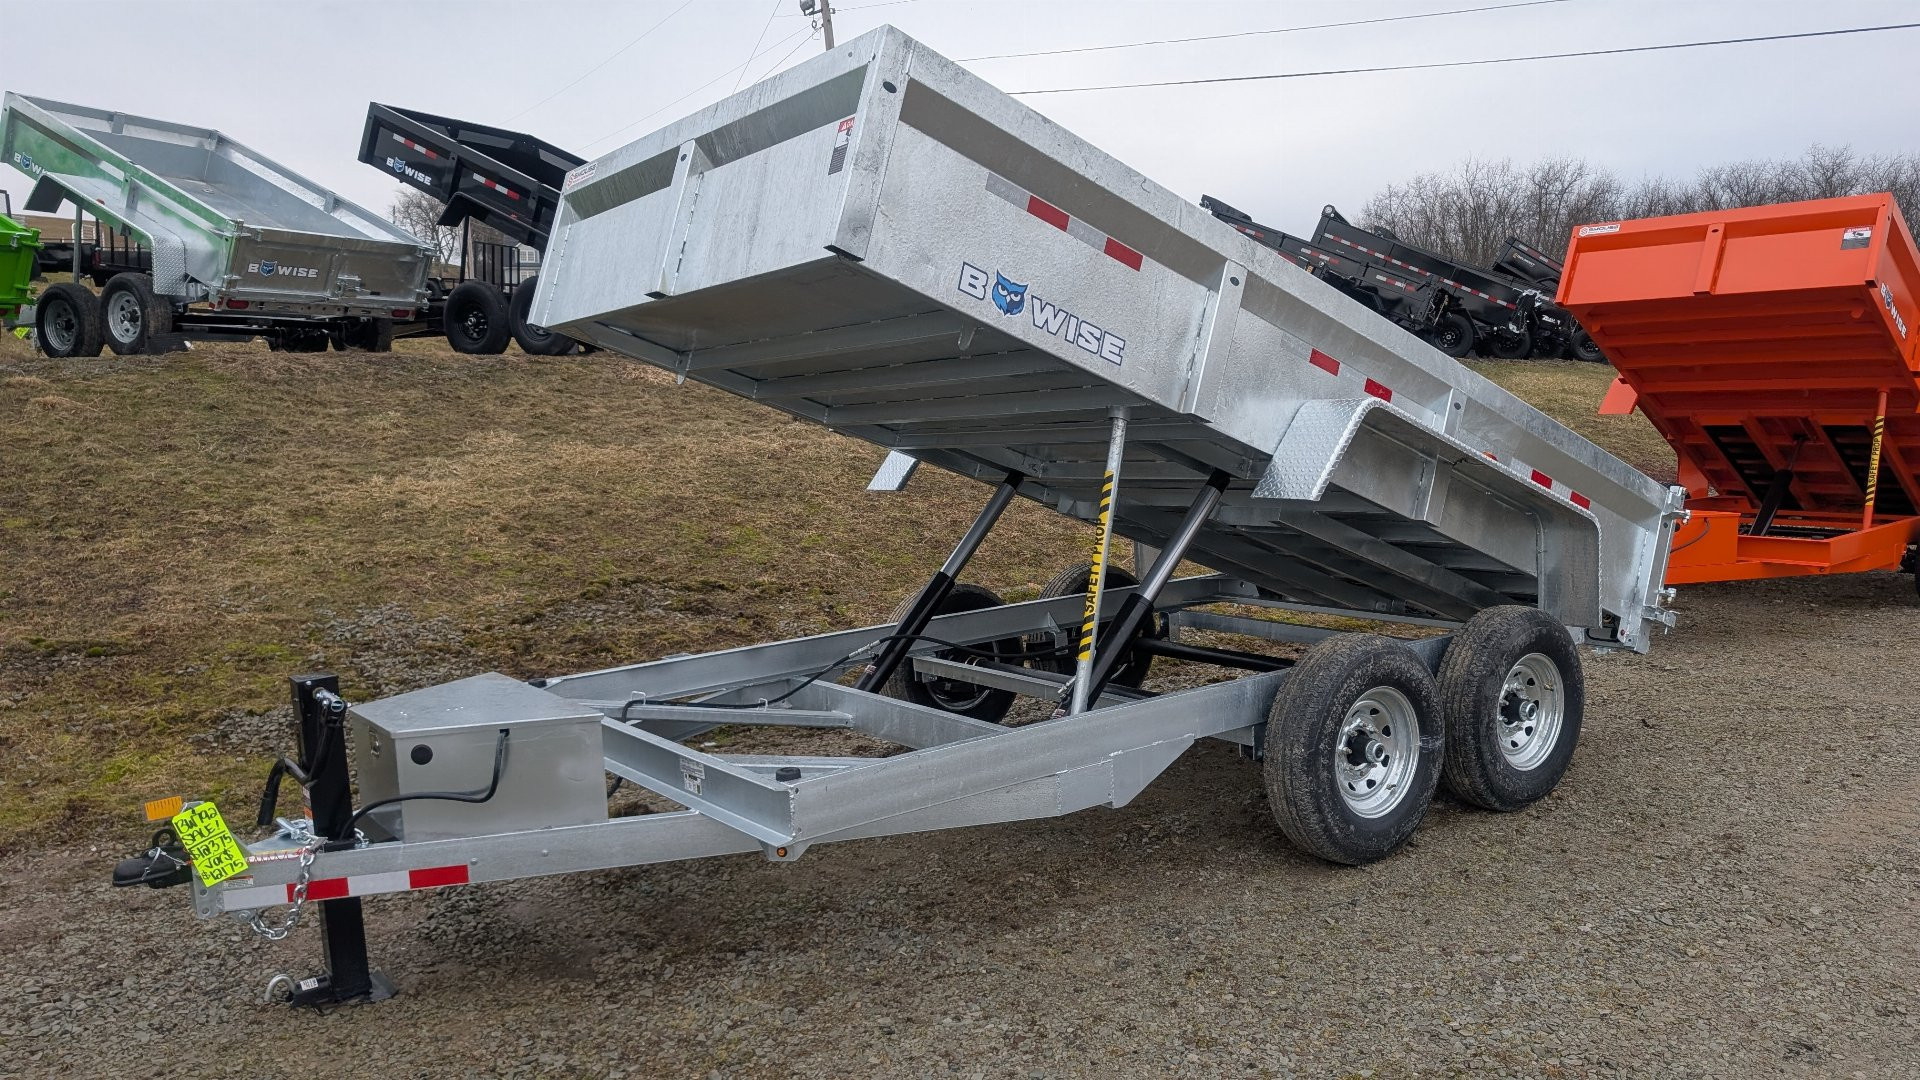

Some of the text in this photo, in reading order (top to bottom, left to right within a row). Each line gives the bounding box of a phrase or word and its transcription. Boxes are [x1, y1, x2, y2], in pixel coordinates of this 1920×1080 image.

[1869, 437, 1881, 484] SAFETY PROP
[1084, 559, 1101, 613] SAFETY
